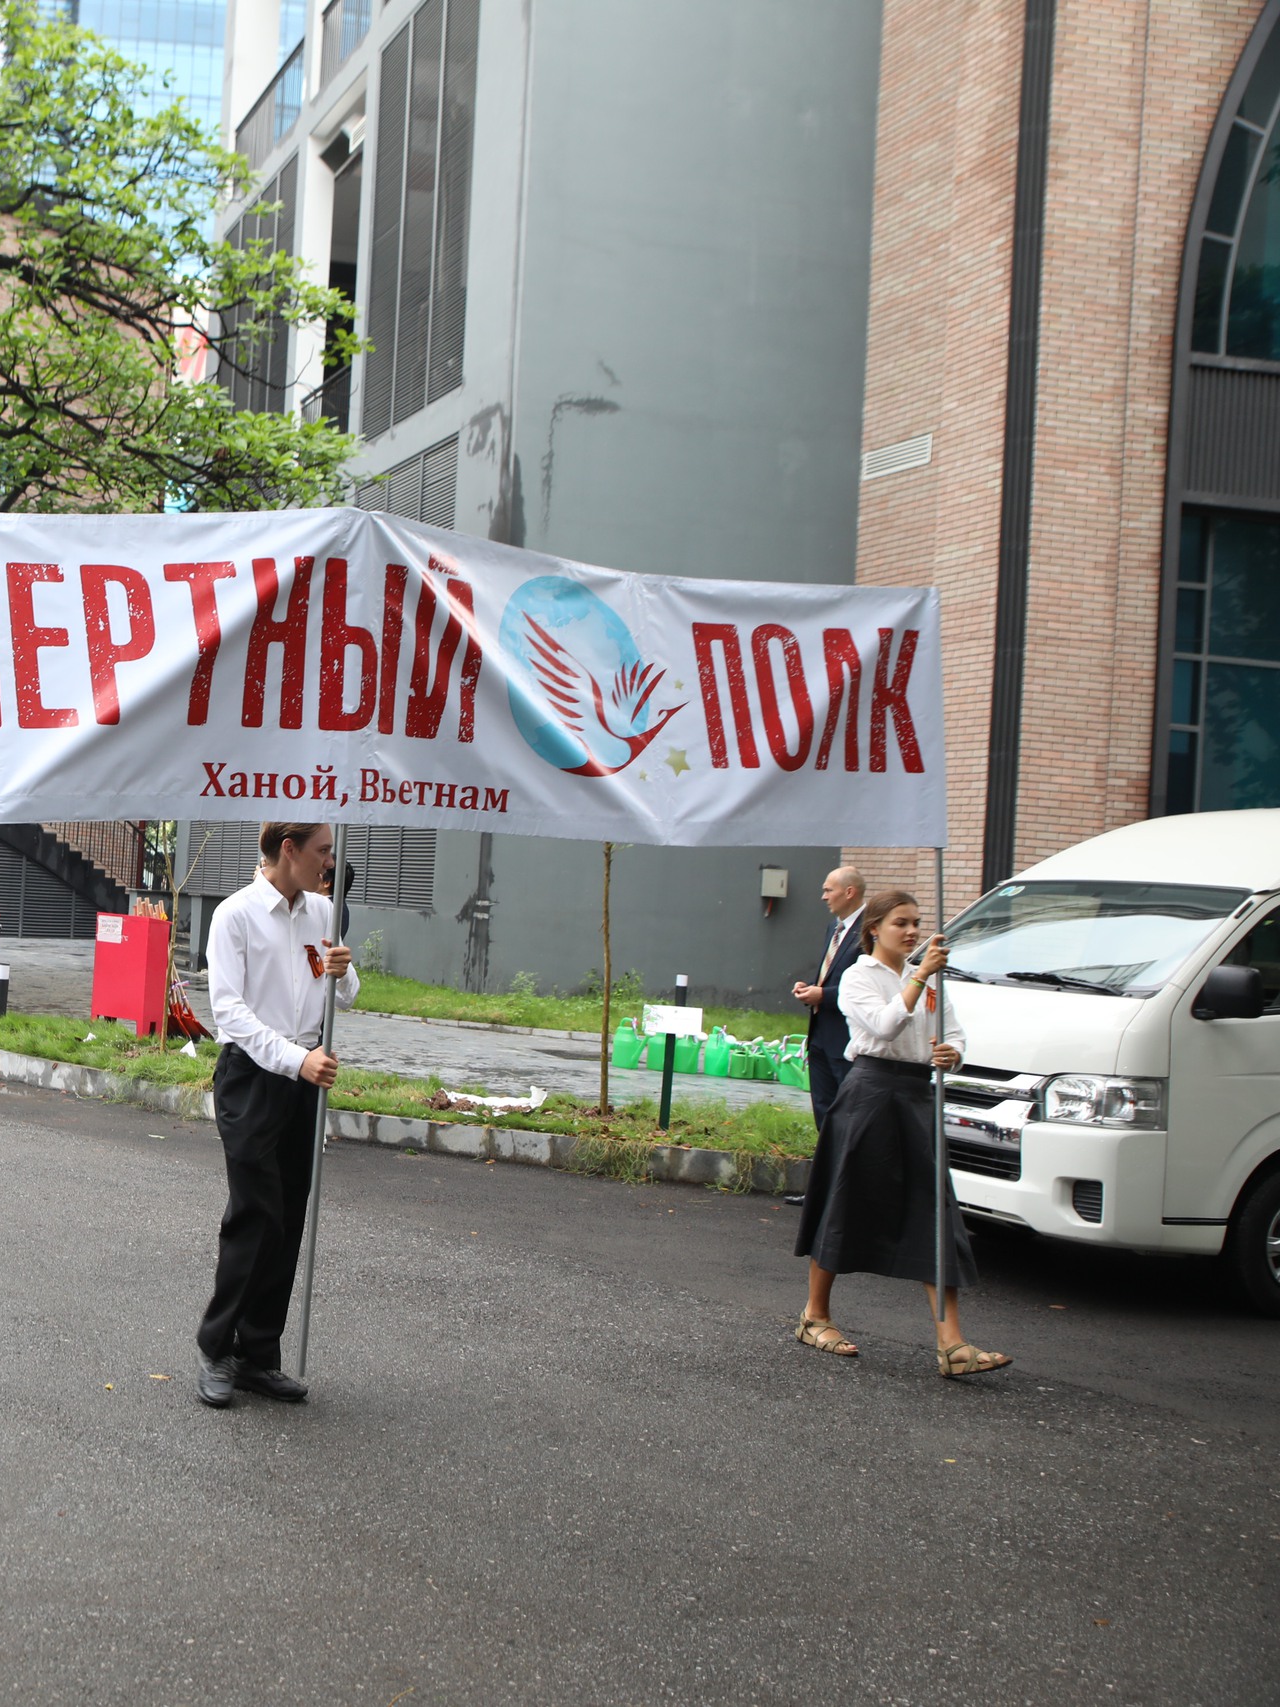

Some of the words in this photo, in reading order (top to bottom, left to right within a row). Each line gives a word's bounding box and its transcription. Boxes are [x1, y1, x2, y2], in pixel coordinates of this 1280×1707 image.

[692, 622, 925, 773] ПОЛК
[200, 762, 348, 807] Ханой,
[359, 768, 510, 813] Вьетнам
